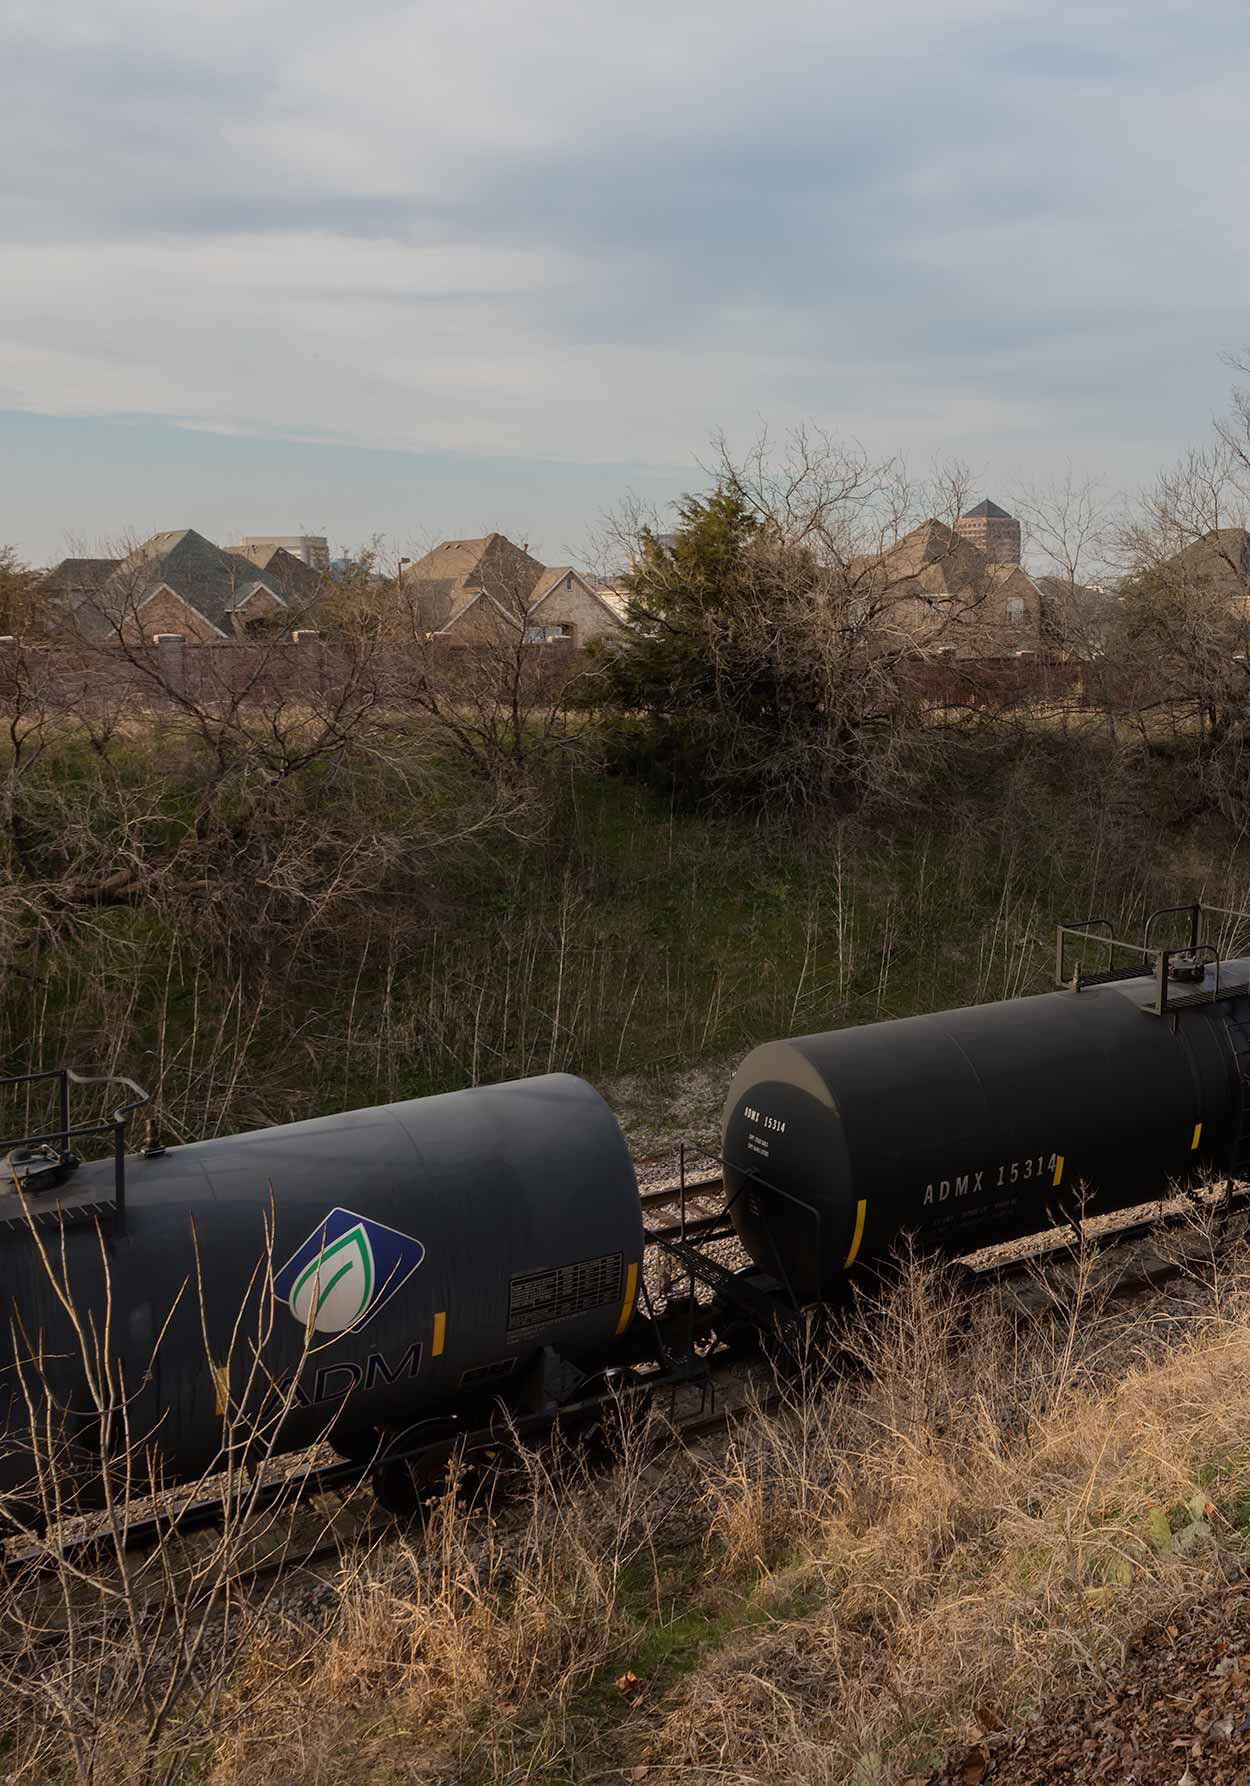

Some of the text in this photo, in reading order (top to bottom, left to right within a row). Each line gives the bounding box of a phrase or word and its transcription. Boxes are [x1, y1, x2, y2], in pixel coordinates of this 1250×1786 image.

[744, 1106, 786, 1133] ADMX 15314
[922, 1152, 1057, 1206] ADMX 15314
[261, 1343, 424, 1423] ADM
